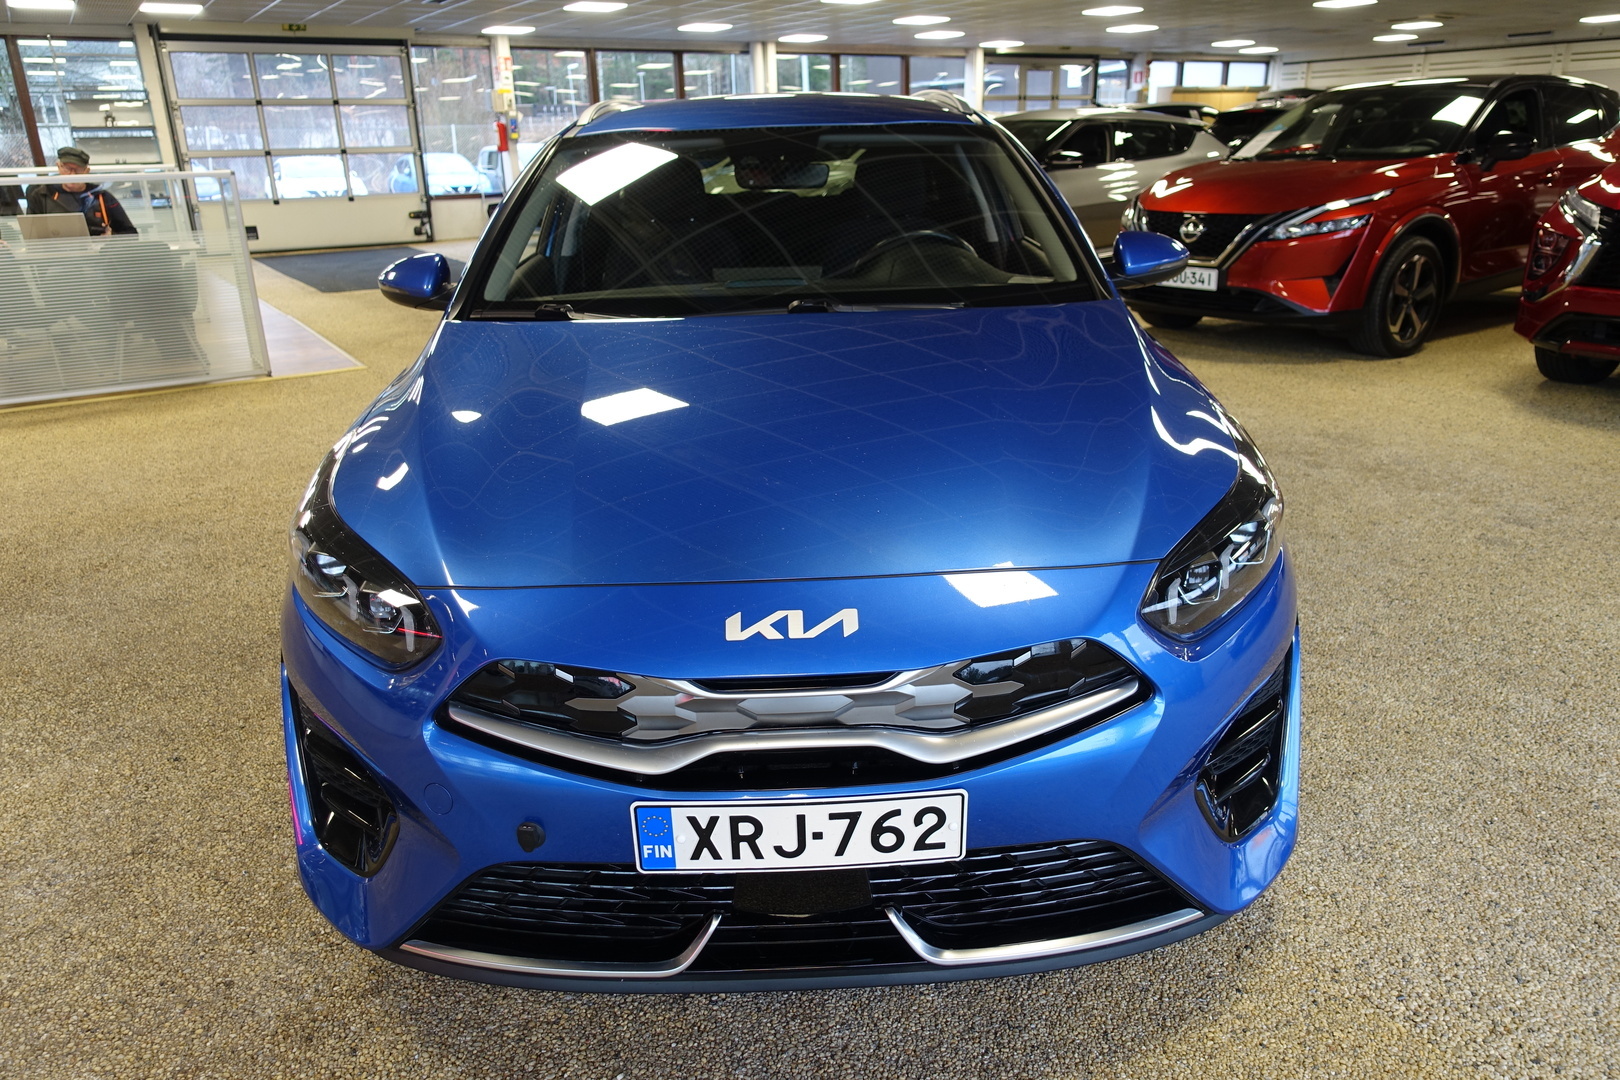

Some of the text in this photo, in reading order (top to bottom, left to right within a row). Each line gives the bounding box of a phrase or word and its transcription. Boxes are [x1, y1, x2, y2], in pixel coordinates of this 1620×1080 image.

[1166, 271, 1211, 286] U-341
[725, 608, 859, 641] KIA
[643, 806, 947, 861] FIN XRJ-762
